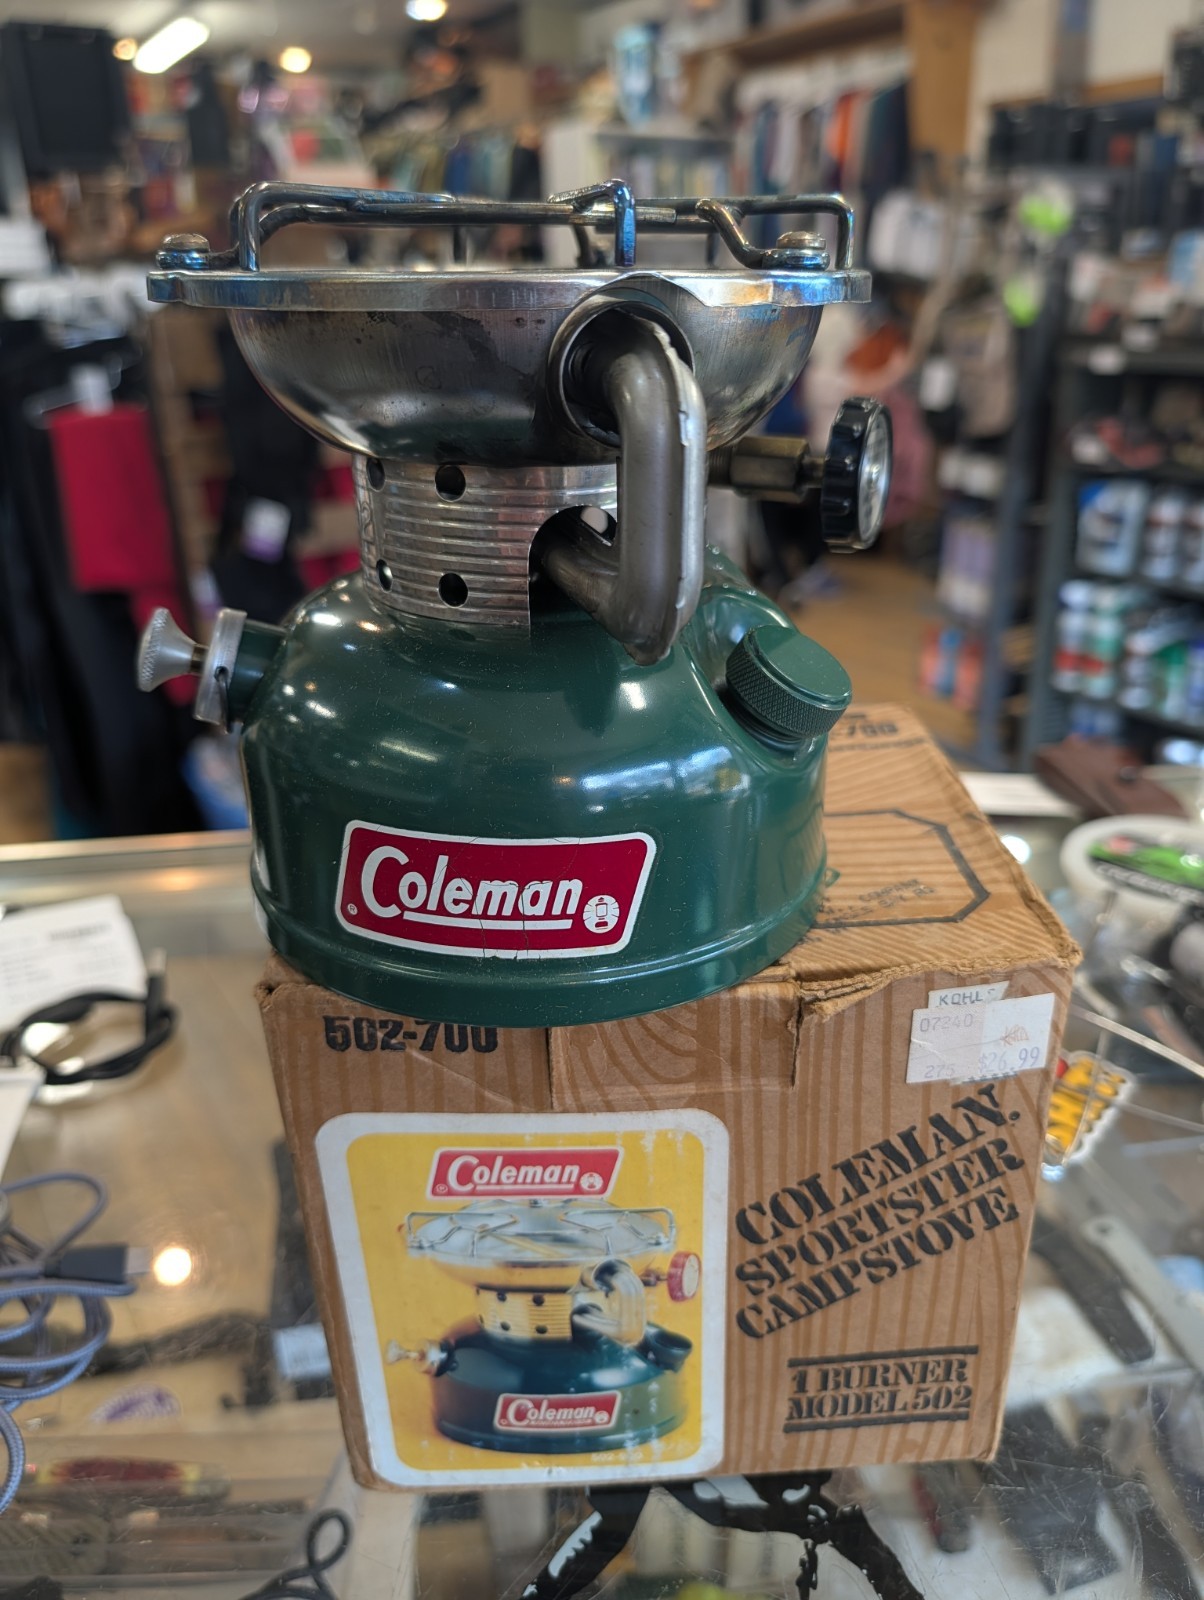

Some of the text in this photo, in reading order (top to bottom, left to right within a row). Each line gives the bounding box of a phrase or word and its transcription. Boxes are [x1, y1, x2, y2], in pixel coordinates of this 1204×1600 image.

[360, 845, 583, 919] Coleman
[322, 1015, 499, 1053] 502-700
[977, 1046, 1041, 1073] $26.99
[446, 1155, 581, 1192] Coleman
[735, 1137, 1025, 1296] SPORTSTER
[736, 1186, 1019, 1338] CAMPSTOVE
[791, 1359, 968, 1393] 1 BURNER
[506, 1399, 596, 1426] Coleman
[785, 1385, 973, 1421] MODEL 502
